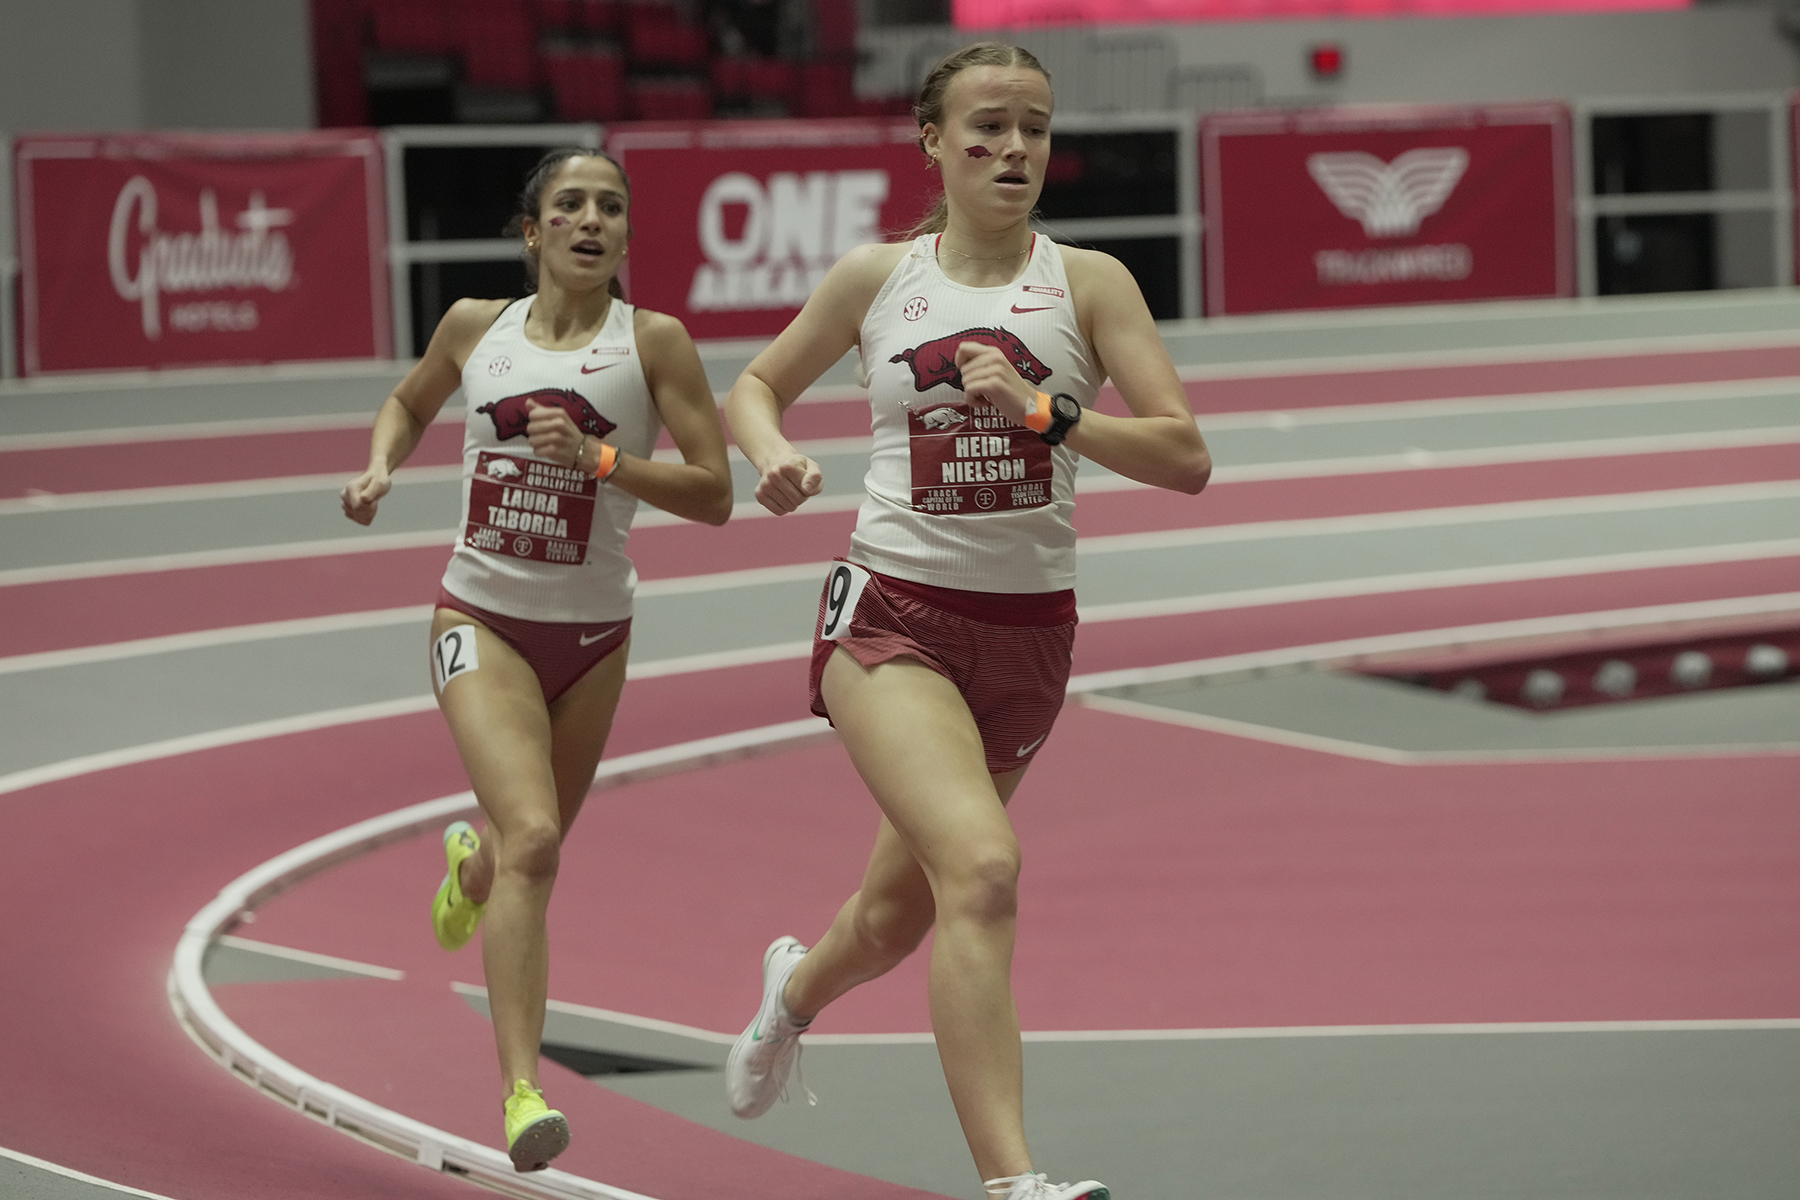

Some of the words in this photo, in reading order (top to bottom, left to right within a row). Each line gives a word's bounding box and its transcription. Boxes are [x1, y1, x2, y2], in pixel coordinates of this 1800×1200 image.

[698, 170, 889, 264] ONE
[687, 262, 832, 313] ARKA
[904, 297, 928, 321] SEC
[974, 417, 1027, 430] QUALI
[955, 436, 1011, 458] HEIDI
[526, 474, 583, 493] QUALIFIER
[528, 462, 585, 482] ARKANSAS
[941, 458, 1026, 484] NIELSON
[501, 486, 559, 515] LAURA
[927, 489, 958, 498] TRACK
[927, 502, 959, 511] WORLD
[488, 505, 568, 539] TABORDA
[824, 565, 852, 637] 9
[436, 631, 466, 683] 12
